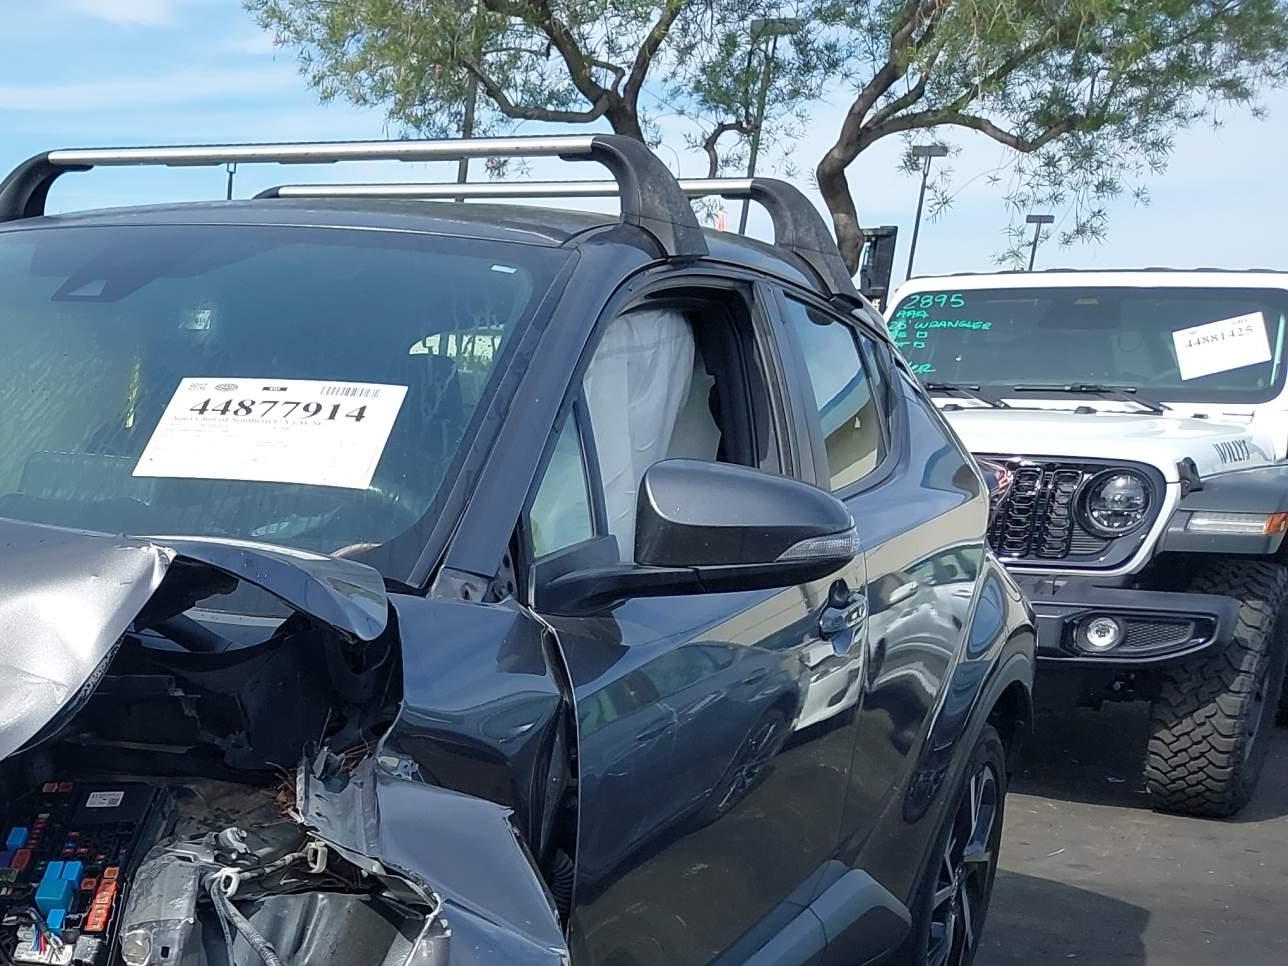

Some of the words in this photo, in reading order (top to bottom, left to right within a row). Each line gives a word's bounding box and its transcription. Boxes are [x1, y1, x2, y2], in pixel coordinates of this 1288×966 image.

[903, 293, 965, 310] 2895
[914, 319, 992, 331] WRANGLER
[189, 397, 368, 424] 44877914
[1212, 439, 1251, 465] WILLYS
